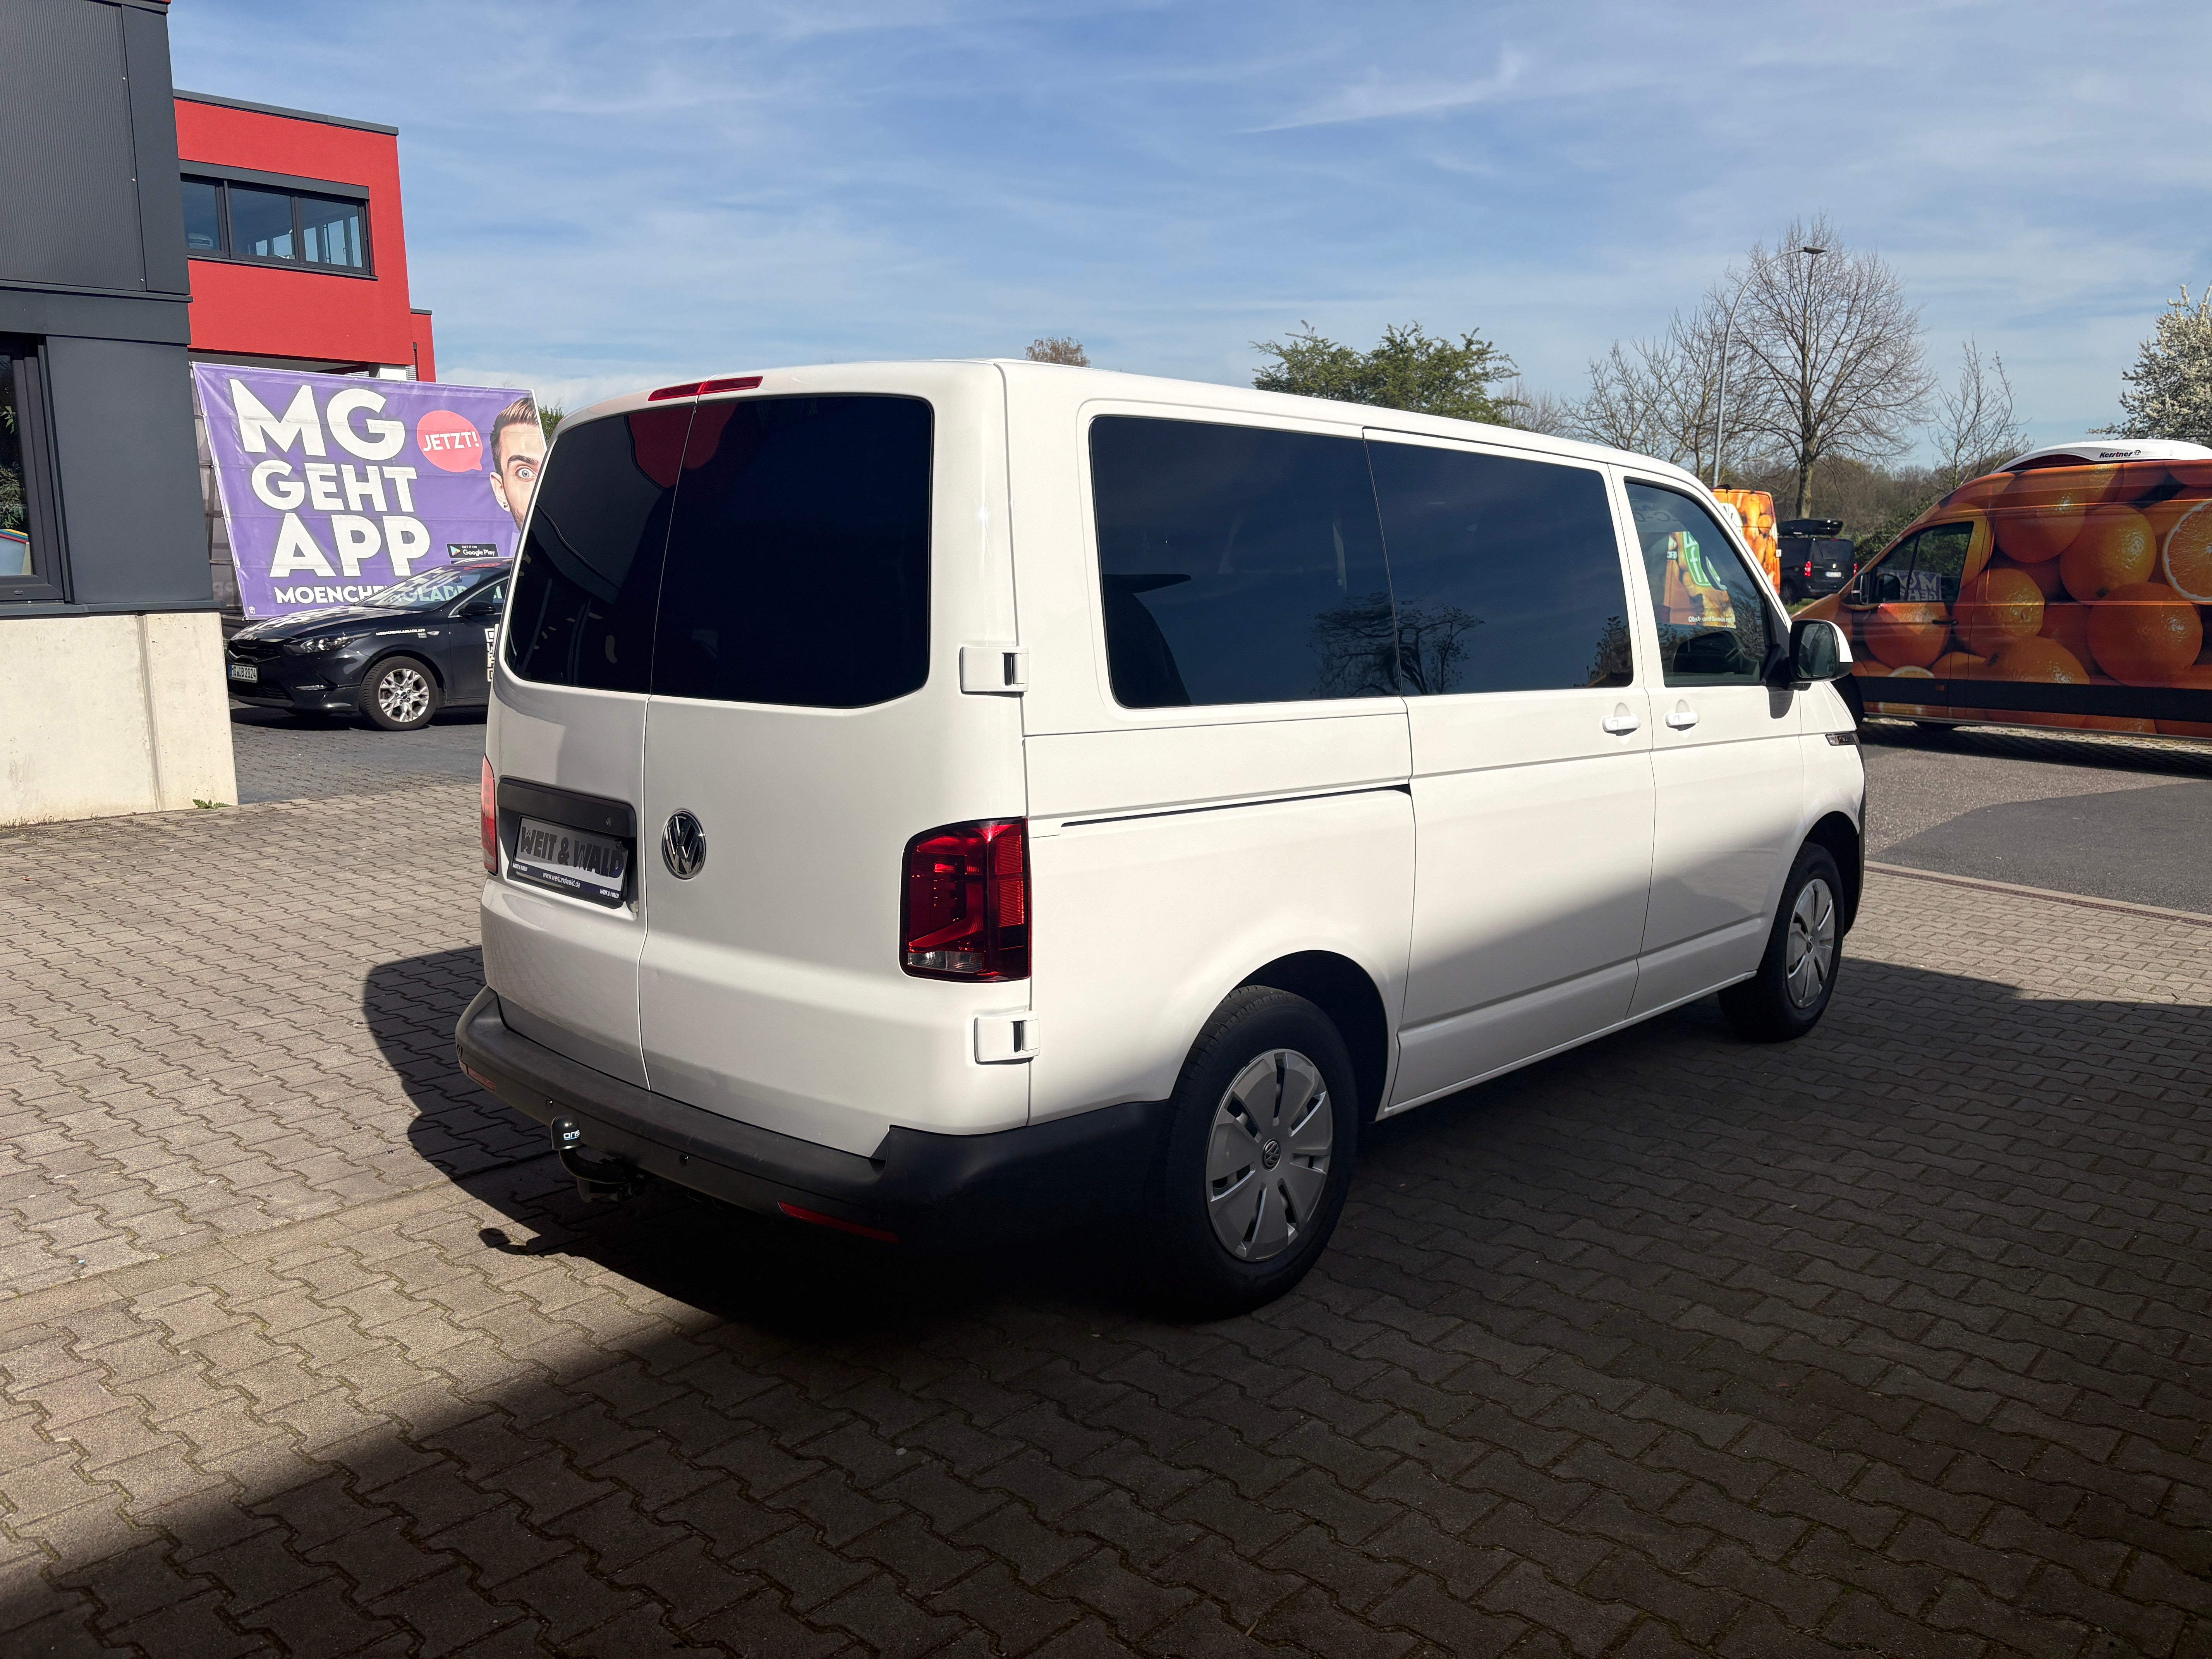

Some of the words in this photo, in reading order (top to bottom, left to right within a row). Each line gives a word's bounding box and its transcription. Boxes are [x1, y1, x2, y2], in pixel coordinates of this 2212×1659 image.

[230, 378, 405, 460] MG
[423, 431, 480, 452] JETZT!
[251, 459, 417, 512] GEHT
[270, 513, 430, 577] APP
[245, 668, 256, 679] 2024
[520, 826, 557, 861] WEIT
[558, 837, 570, 866] &
[573, 840, 624, 878] WALD
[543, 872, 580, 888] www.weitundwald.de
[563, 1130, 580, 1139] oris
